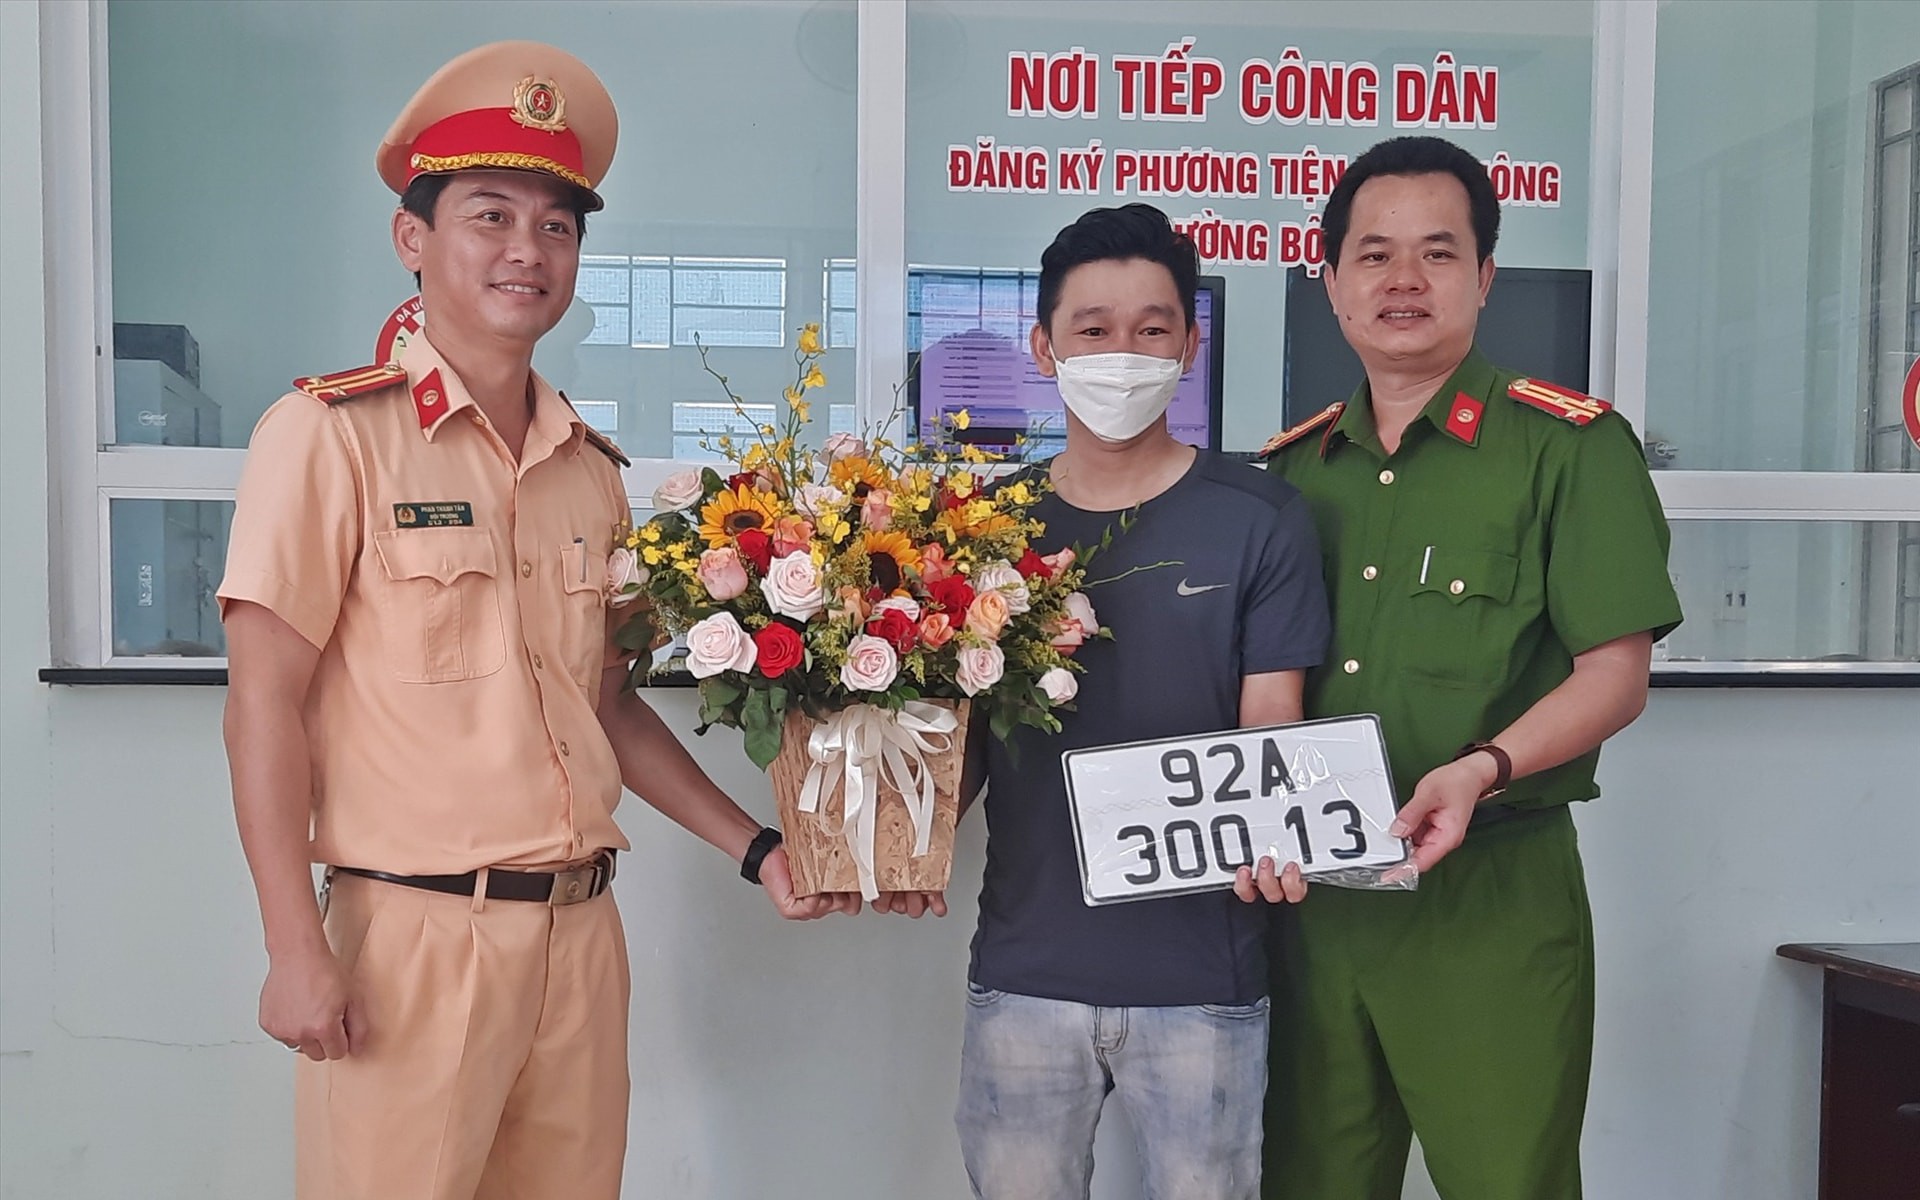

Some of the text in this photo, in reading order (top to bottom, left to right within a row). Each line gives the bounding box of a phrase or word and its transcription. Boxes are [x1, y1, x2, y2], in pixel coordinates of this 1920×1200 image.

[1011, 41, 1497, 122] NƠI TIẾP CÔNG DÂN
[948, 142, 1559, 203] ĐĂNG KÝ PHƯƠNG TIỆN ÔNG
[1280, 215, 1324, 276] BỘ
[1160, 737, 1297, 808] 92A
